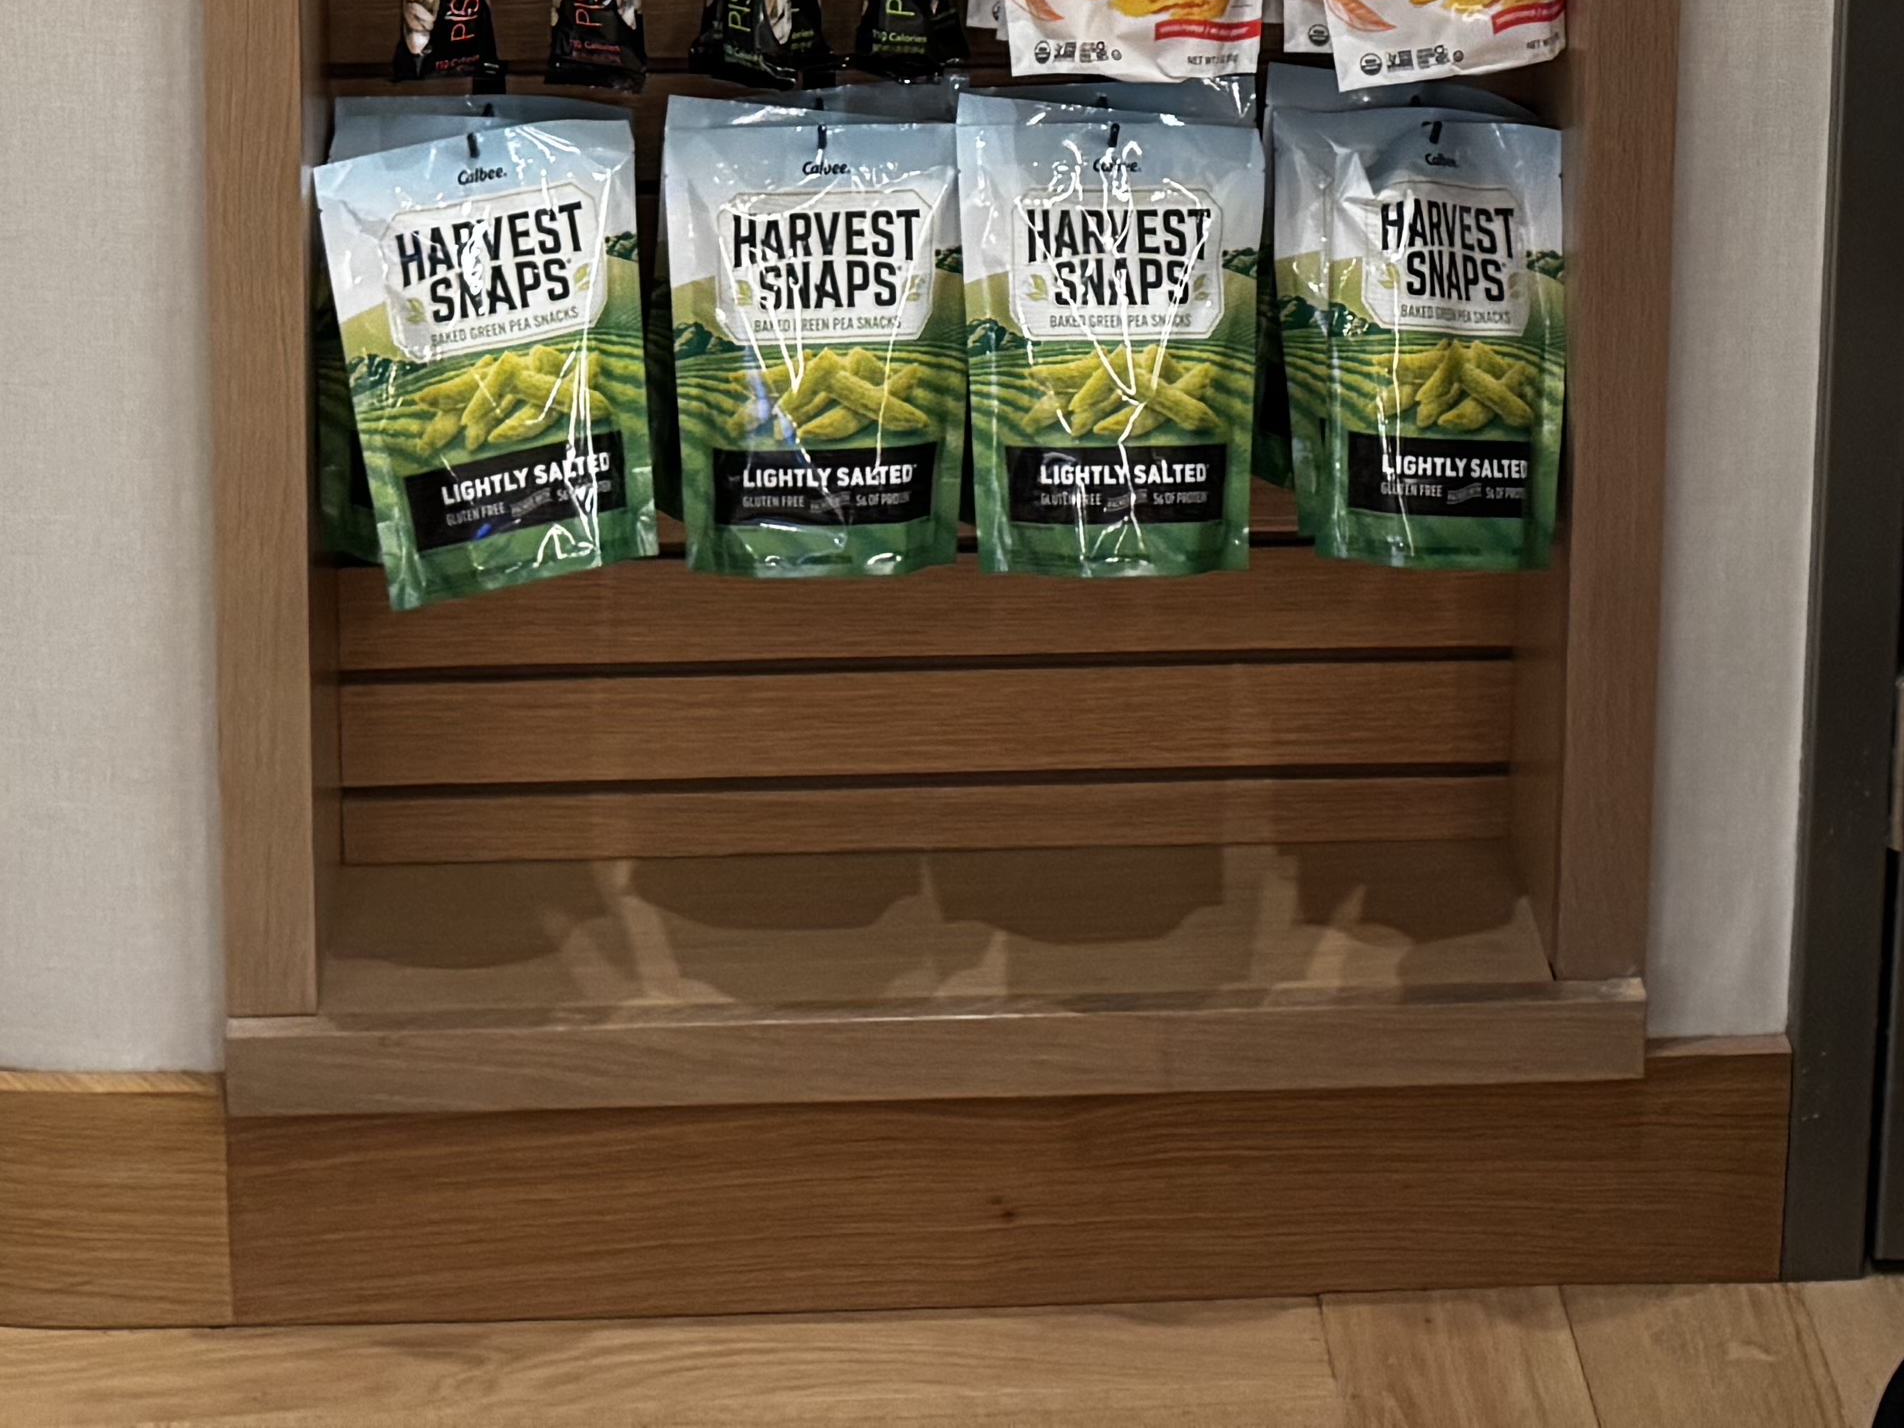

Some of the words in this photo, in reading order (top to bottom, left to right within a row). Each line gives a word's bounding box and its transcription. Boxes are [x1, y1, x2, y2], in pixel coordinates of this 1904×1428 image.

[733, 209, 921, 268] HARVEST
[1381, 204, 1514, 260] HARVEST
[759, 261, 898, 311] SNAPS
[1406, 254, 1505, 302] SNAPS
[743, 467, 830, 489] LIGHTLY
[835, 465, 913, 485] SALTED
[1382, 455, 1467, 480] LIGHTLY
[1470, 459, 1528, 479] SALTED
